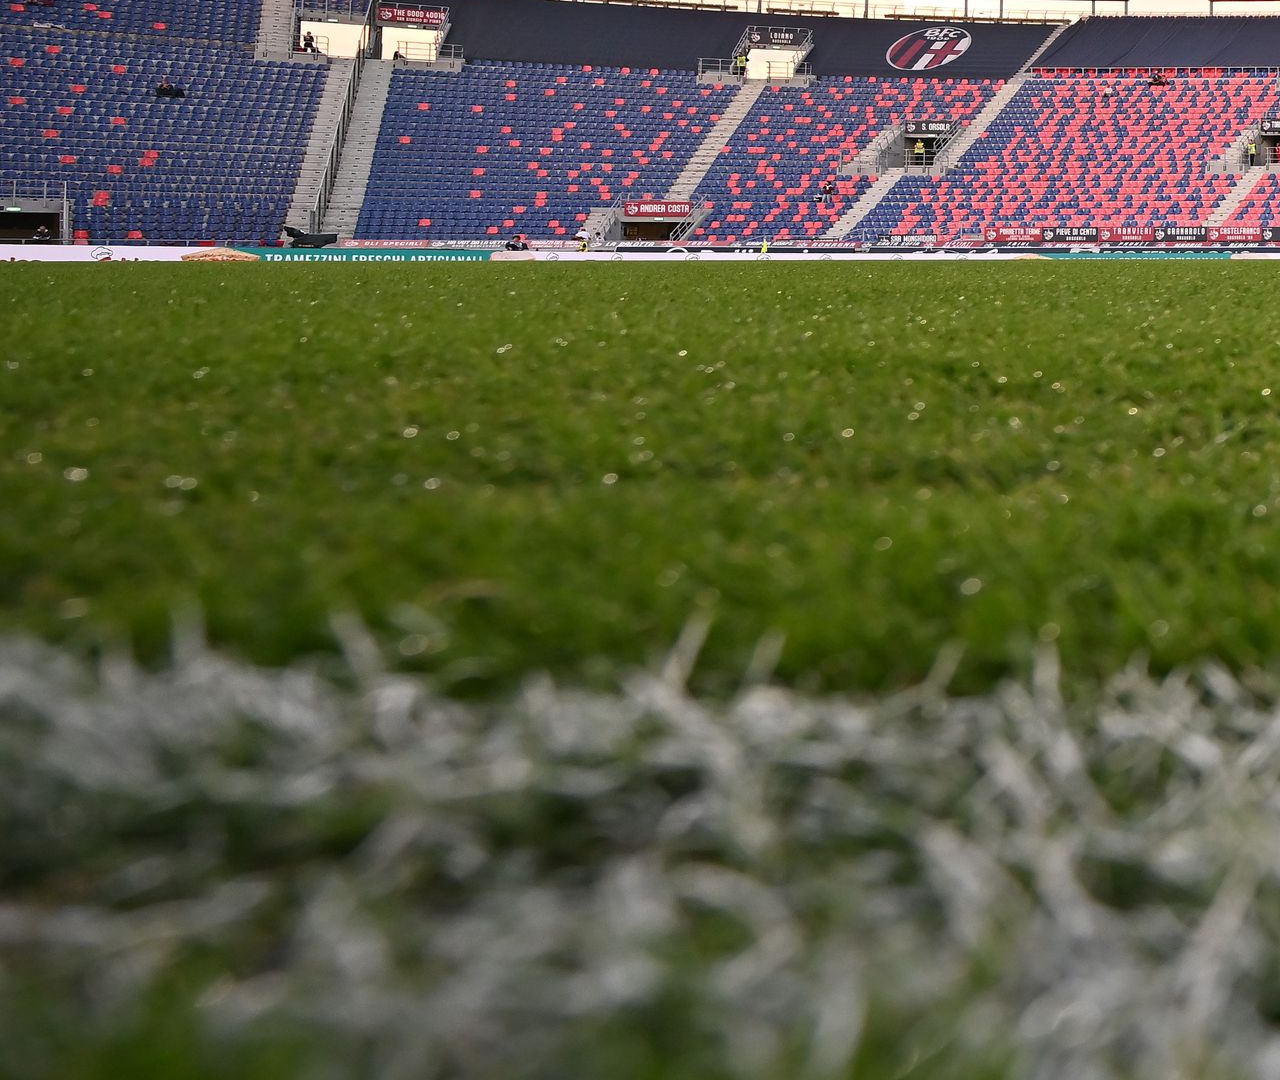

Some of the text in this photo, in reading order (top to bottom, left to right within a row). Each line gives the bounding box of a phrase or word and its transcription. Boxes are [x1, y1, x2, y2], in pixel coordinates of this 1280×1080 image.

[393, 8, 405, 16] THE
[407, 9, 424, 17] GOOD
[923, 29, 961, 38] BFC
[921, 123, 951, 131] S. ORSOLA
[640, 204, 690, 213] ANDREA COSTA
[1056, 228, 1097, 236] PIEVE DI CENTO
[1220, 227, 1260, 235] CASTELFRANCO
